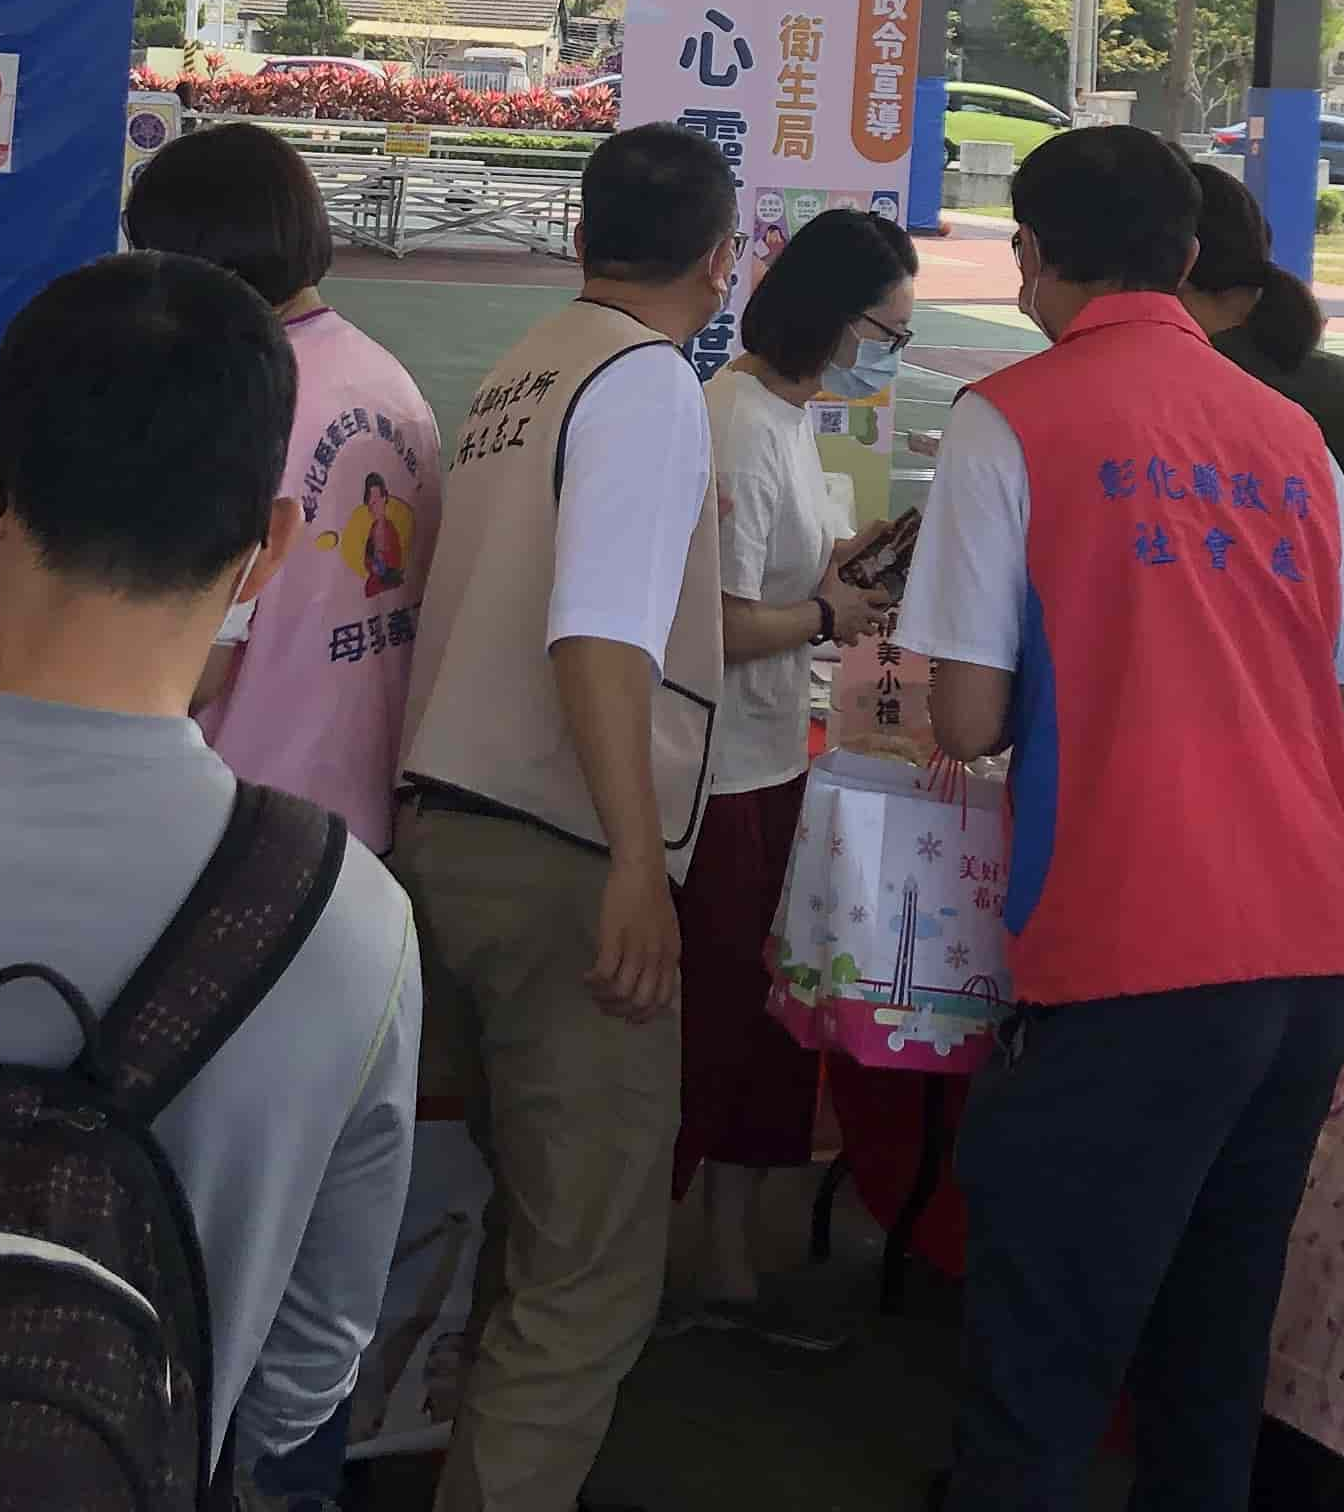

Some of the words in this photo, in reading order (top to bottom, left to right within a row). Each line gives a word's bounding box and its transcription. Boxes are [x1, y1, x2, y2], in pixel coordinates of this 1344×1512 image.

[772, 14, 825, 162] 衛生局
[1098, 455, 1312, 520] 彰化縣政府
